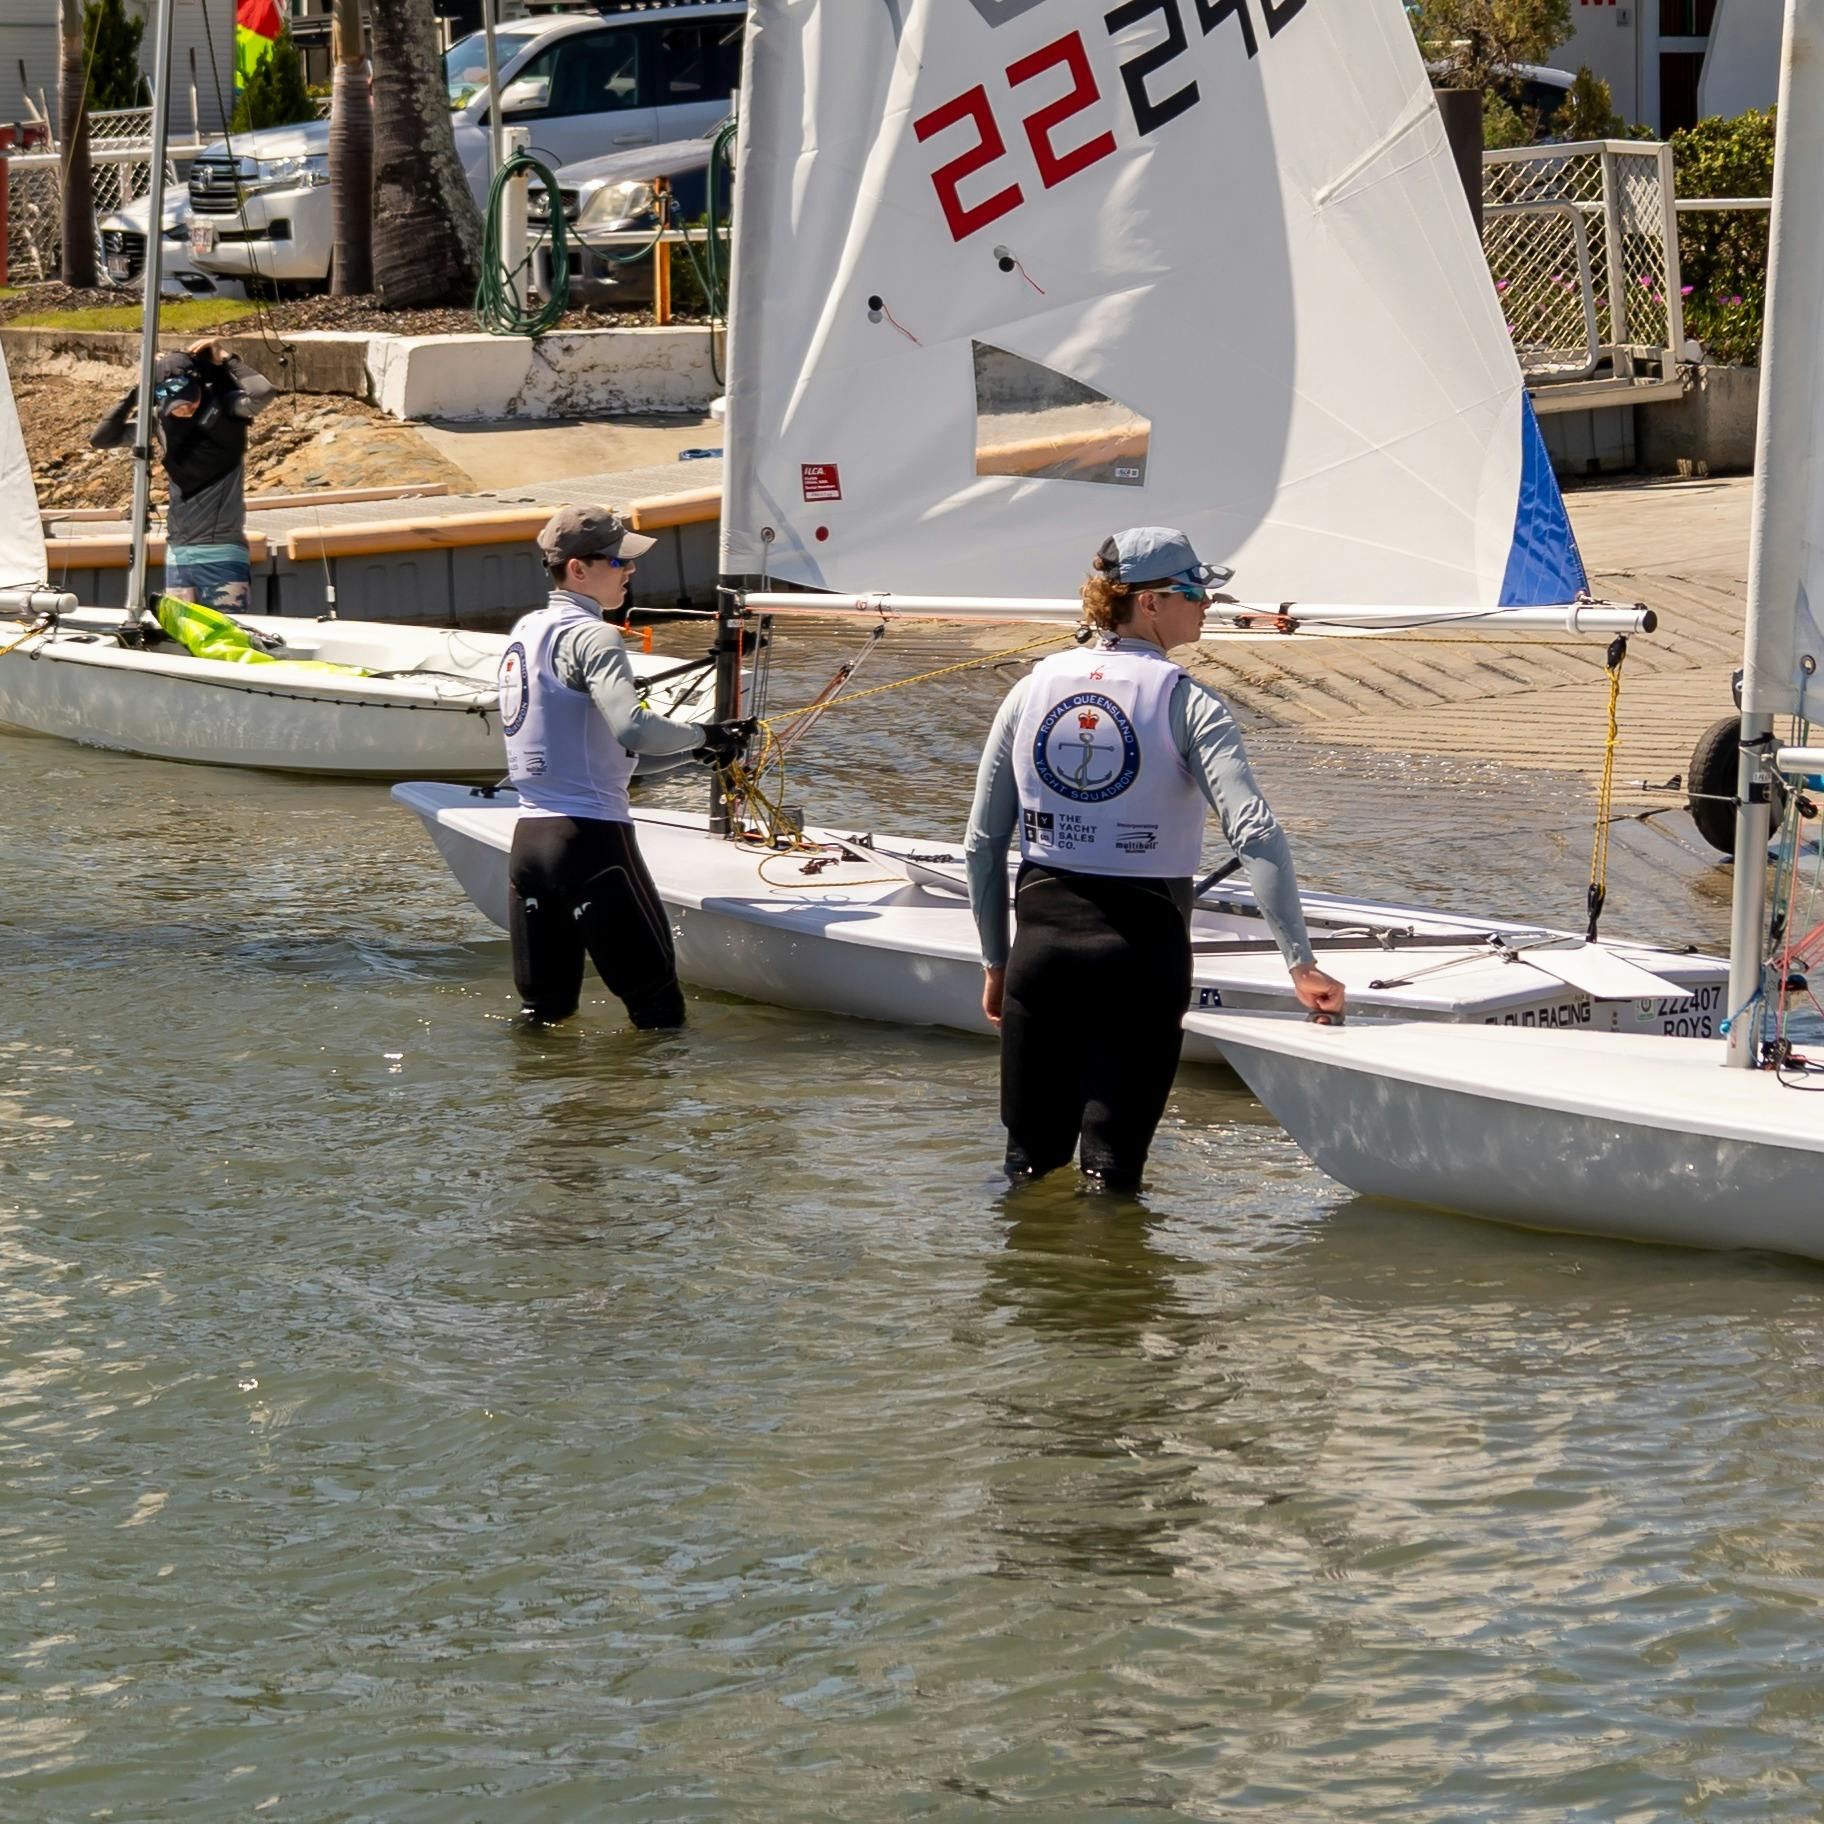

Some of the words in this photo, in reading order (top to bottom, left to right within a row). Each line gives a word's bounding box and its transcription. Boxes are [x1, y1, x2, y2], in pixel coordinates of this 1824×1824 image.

[804, 467, 824, 475] ILCA
[1041, 702, 1072, 734] ROYAL
[1073, 694, 1135, 744] QUEENSLAND
[1036, 759, 1068, 793] YACHT
[1070, 769, 1135, 801] SQUADRON
[1059, 814, 1082, 824] THE
[1059, 823, 1098, 834] YACHT
[1058, 832, 1095, 843] SALES
[1058, 841, 1076, 850] CO.
[1539, 1001, 1591, 1027] RACING
